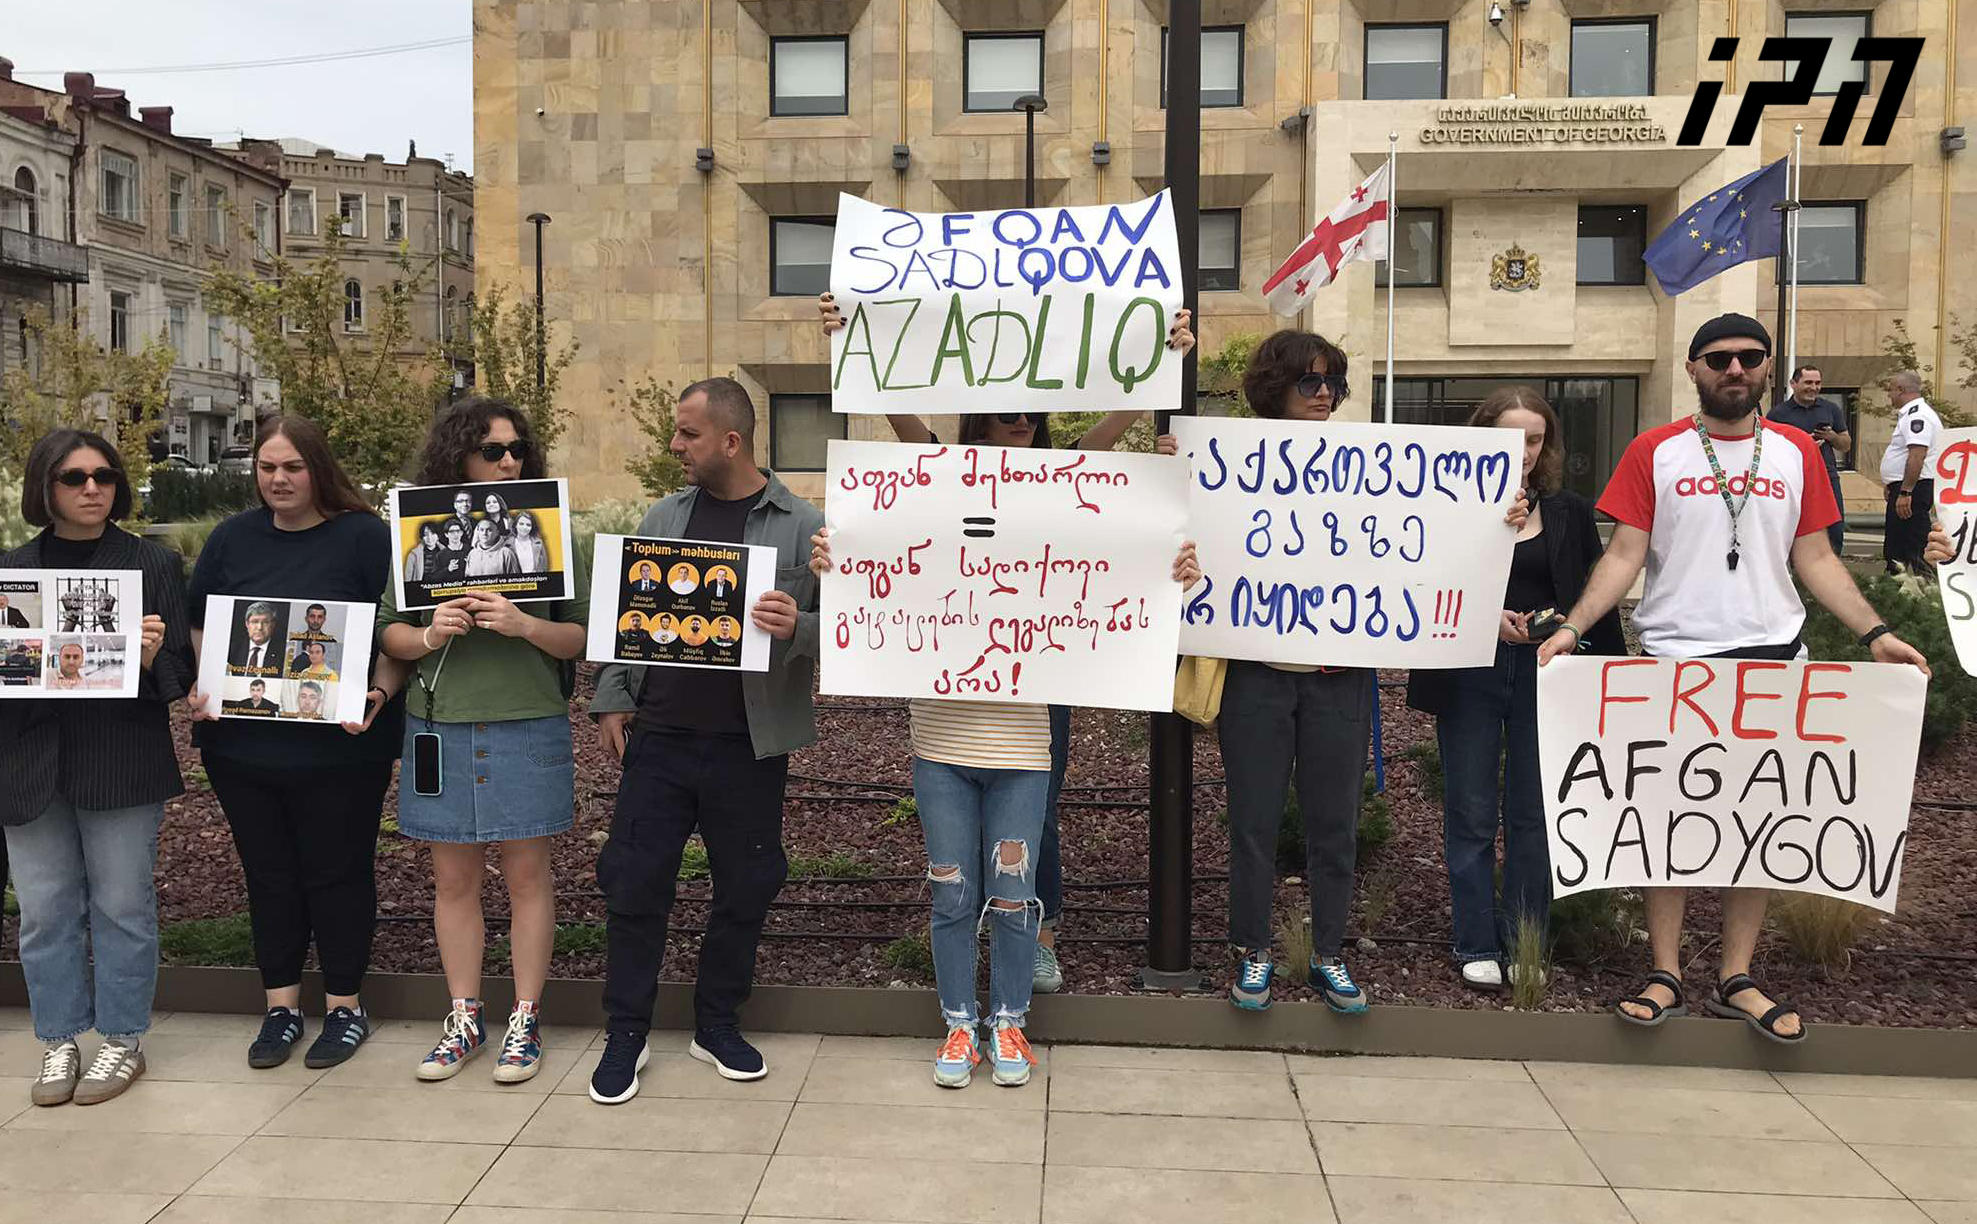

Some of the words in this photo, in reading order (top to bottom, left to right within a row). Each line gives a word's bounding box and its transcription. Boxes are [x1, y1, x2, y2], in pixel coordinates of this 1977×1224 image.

[1420, 127, 1549, 144] GOVERNMENT
[1553, 127, 1581, 143] OF
[1582, 125, 1667, 143] GEORGIA
[834, 292, 1165, 393] AZADLIQ
[841, 448, 948, 511] აფგან
[1187, 437, 1511, 504] აქართველო
[1245, 509, 1425, 563] გაზზე
[840, 539, 932, 599] აფგან
[1181, 573, 1214, 625] რ
[1598, 660, 1852, 744] FREE
[1558, 741, 1857, 807] AFGAN
[1556, 806, 1907, 899] SADYGOV
